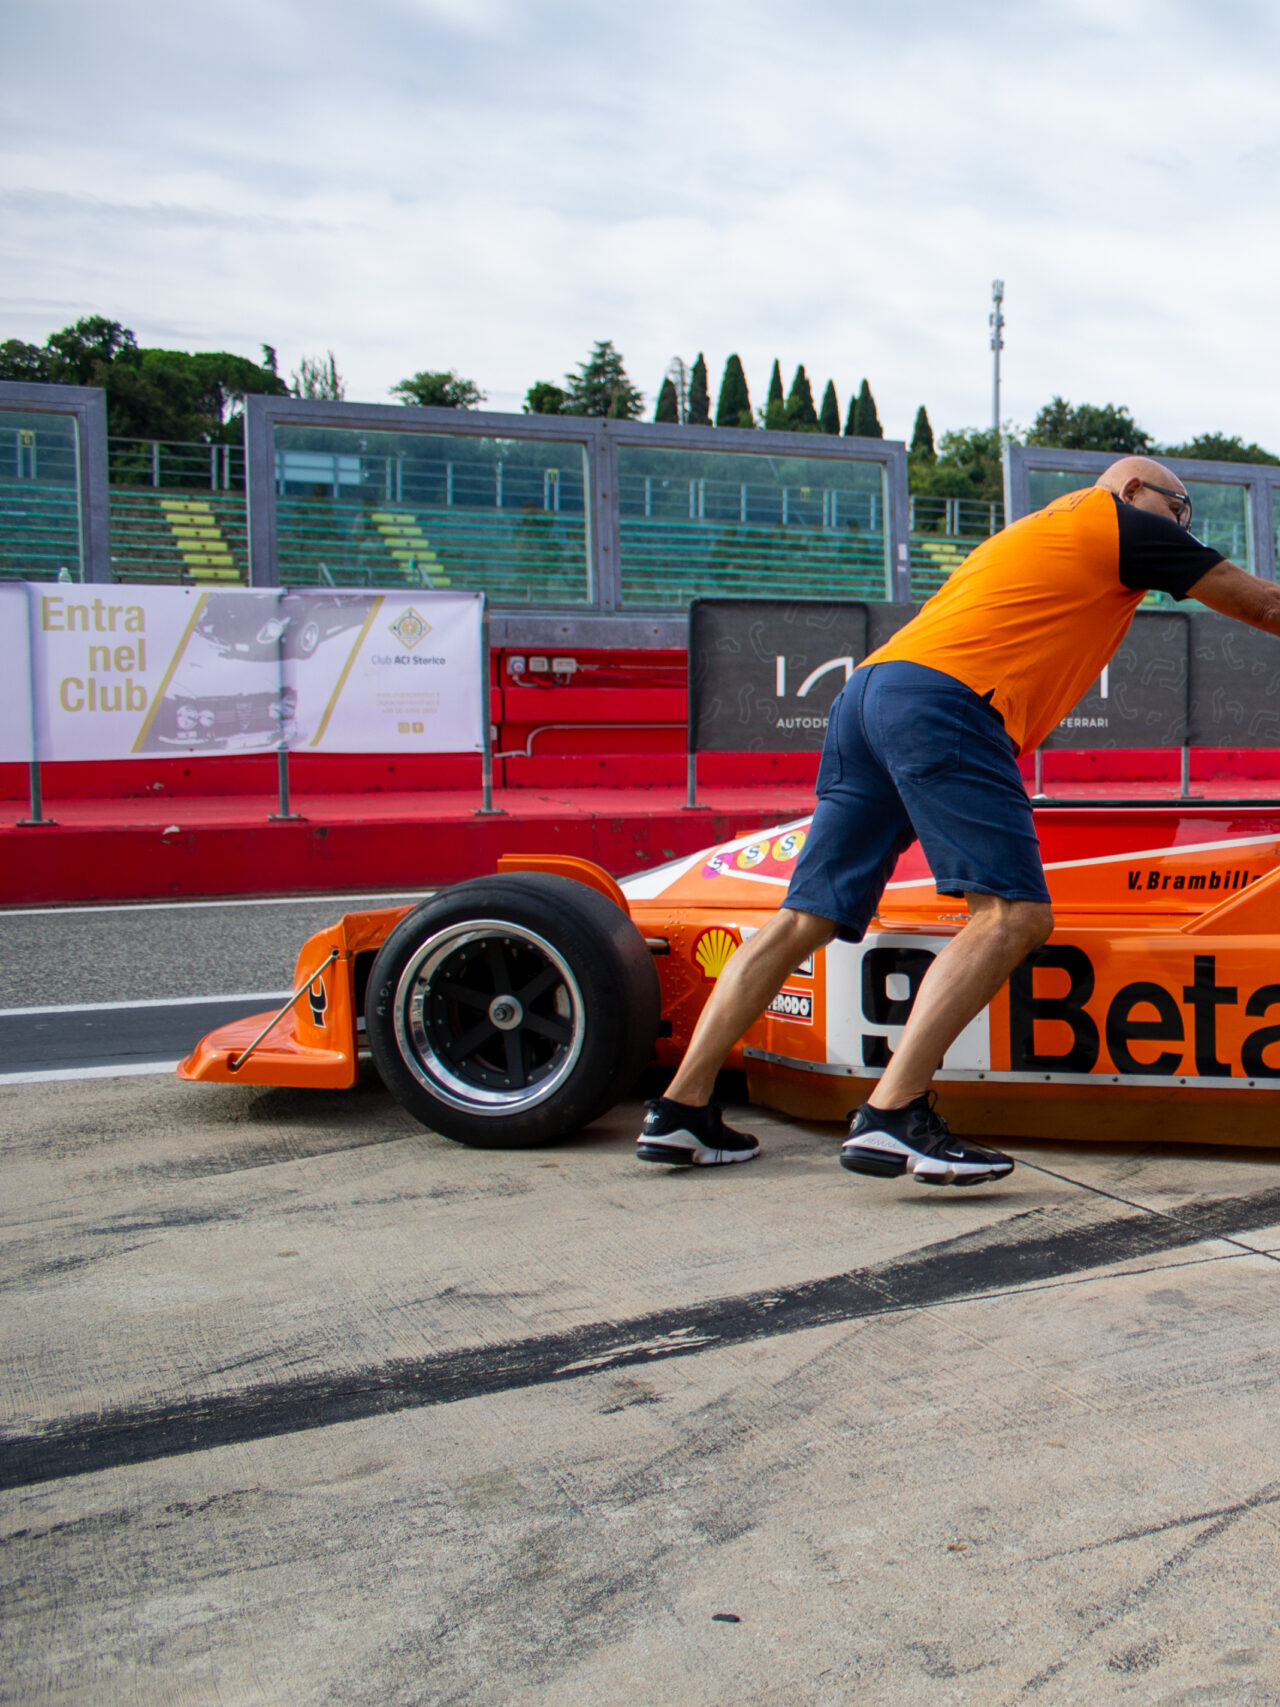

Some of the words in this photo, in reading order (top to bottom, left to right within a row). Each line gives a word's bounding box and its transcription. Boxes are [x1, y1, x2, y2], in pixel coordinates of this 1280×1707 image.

[42, 596, 145, 632] Entra
[88, 638, 146, 672] nel
[370, 655, 393, 665] Club
[394, 655, 411, 665] ACI
[412, 655, 447, 665] Storico
[60, 677, 148, 712] Club
[1060, 717, 1109, 728] FERRARI
[768, 993, 812, 1017] ERODO
